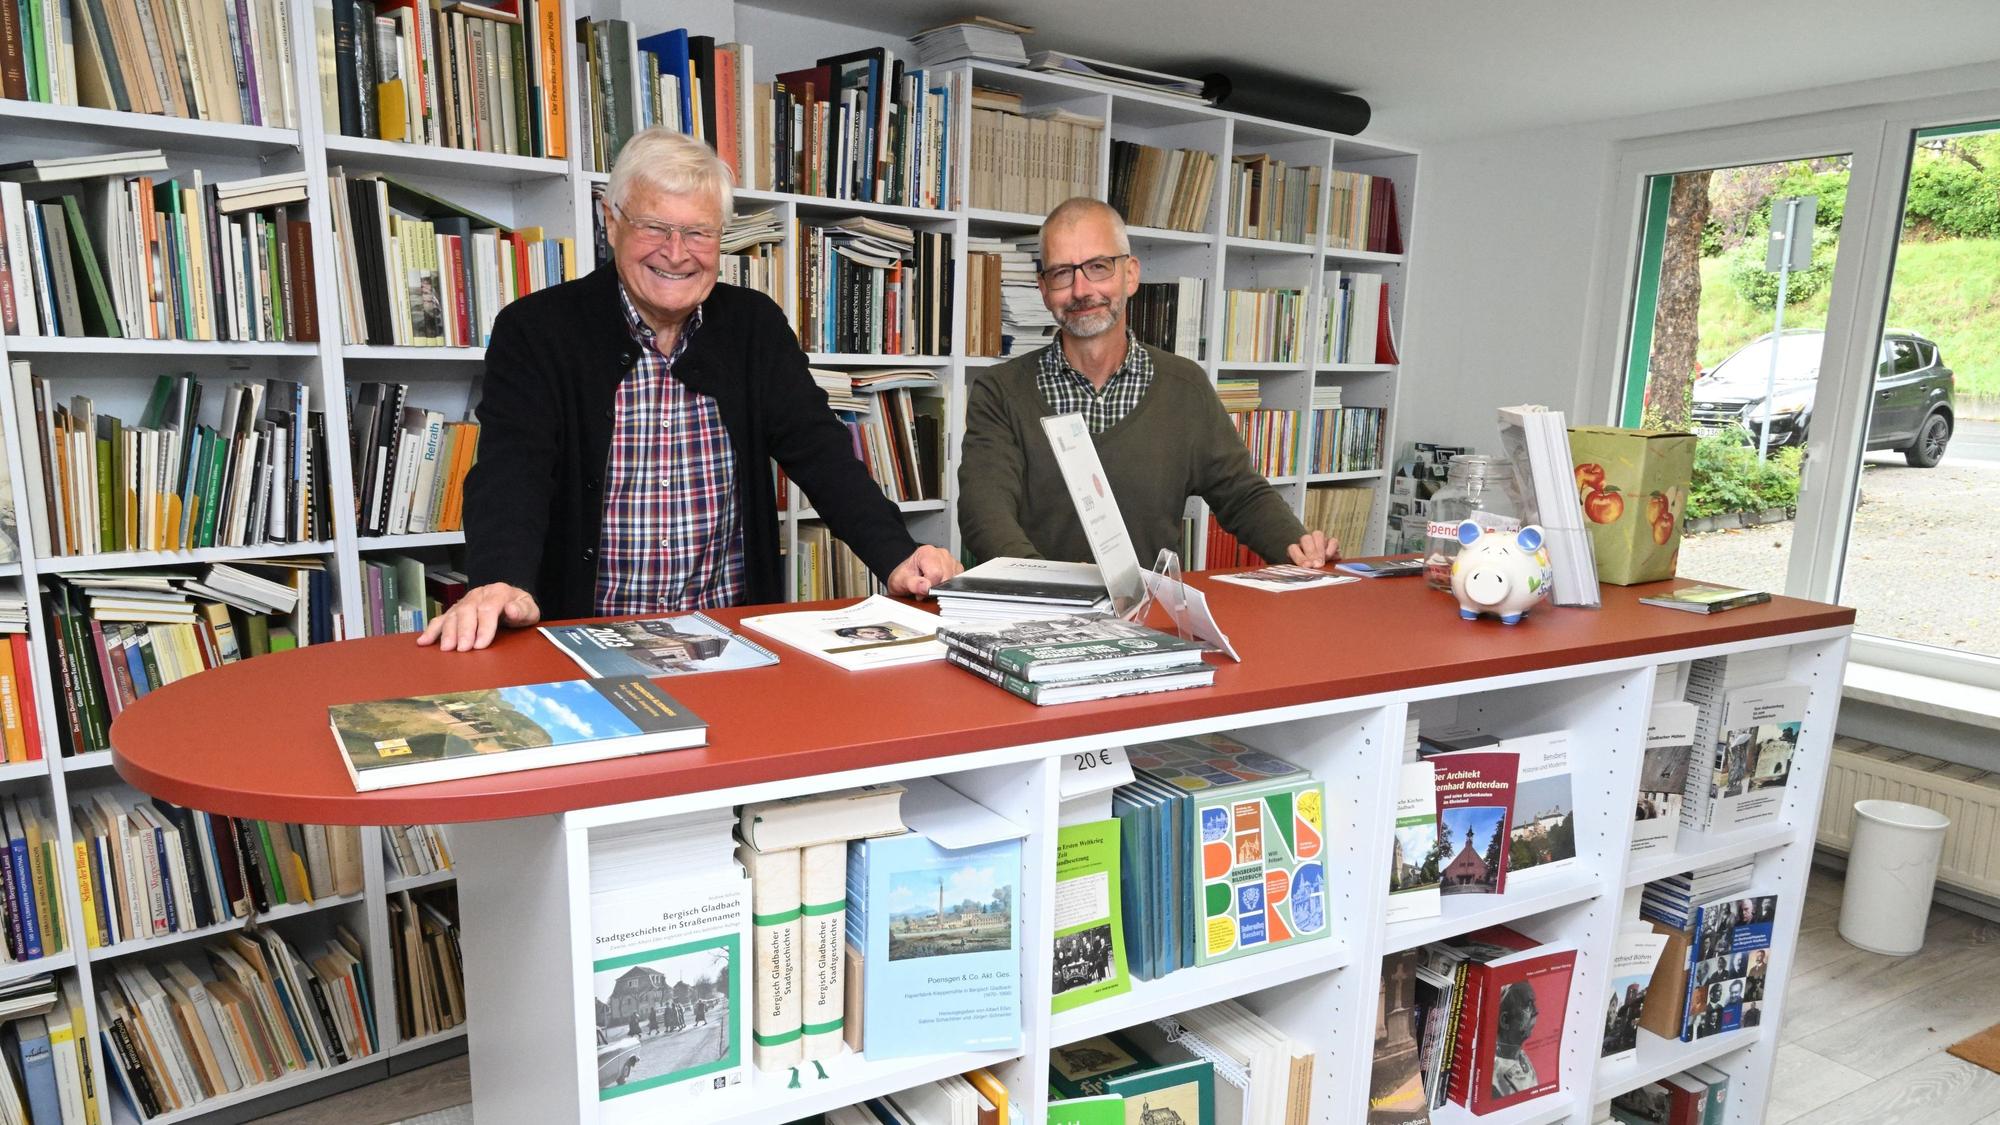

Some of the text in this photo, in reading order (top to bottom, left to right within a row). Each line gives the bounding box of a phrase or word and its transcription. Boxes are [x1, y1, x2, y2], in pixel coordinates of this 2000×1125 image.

[425, 422, 440, 460] Refrath
[1426, 522, 1458, 537] Spend
[586, 628, 634, 647] 2023
[1, 674, 16, 728] Bergische Wege
[1074, 749, 1112, 770] 20 €
[1434, 779, 1508, 791] ernhard Rotterdam
[1446, 770, 1480, 780] Architekt
[1079, 837, 1103, 846] Weltkrieg
[143, 831, 161, 889] Wuppertal erzählt
[1056, 855, 1089, 865] andbesetzung
[1231, 865, 1262, 876] BENSBERGER
[6, 869, 16, 899] Bergischen
[1231, 872, 1262, 883] BILDERBUCH
[82, 879, 91, 901] Schule
[662, 899, 740, 921] Bergisch Gladbach
[594, 924, 667, 946] Stadtgeschichte
[678, 910, 740, 928] Straßennamen
[784, 928, 793, 995] Stadtgeschichte
[830, 918, 839, 985] Stadtgeschichte
[771, 931, 782, 1016] Bergisch Gladbacher
[818, 921, 828, 1005] Bergisch Gladbacher
[927, 974, 960, 984] Poensgen
